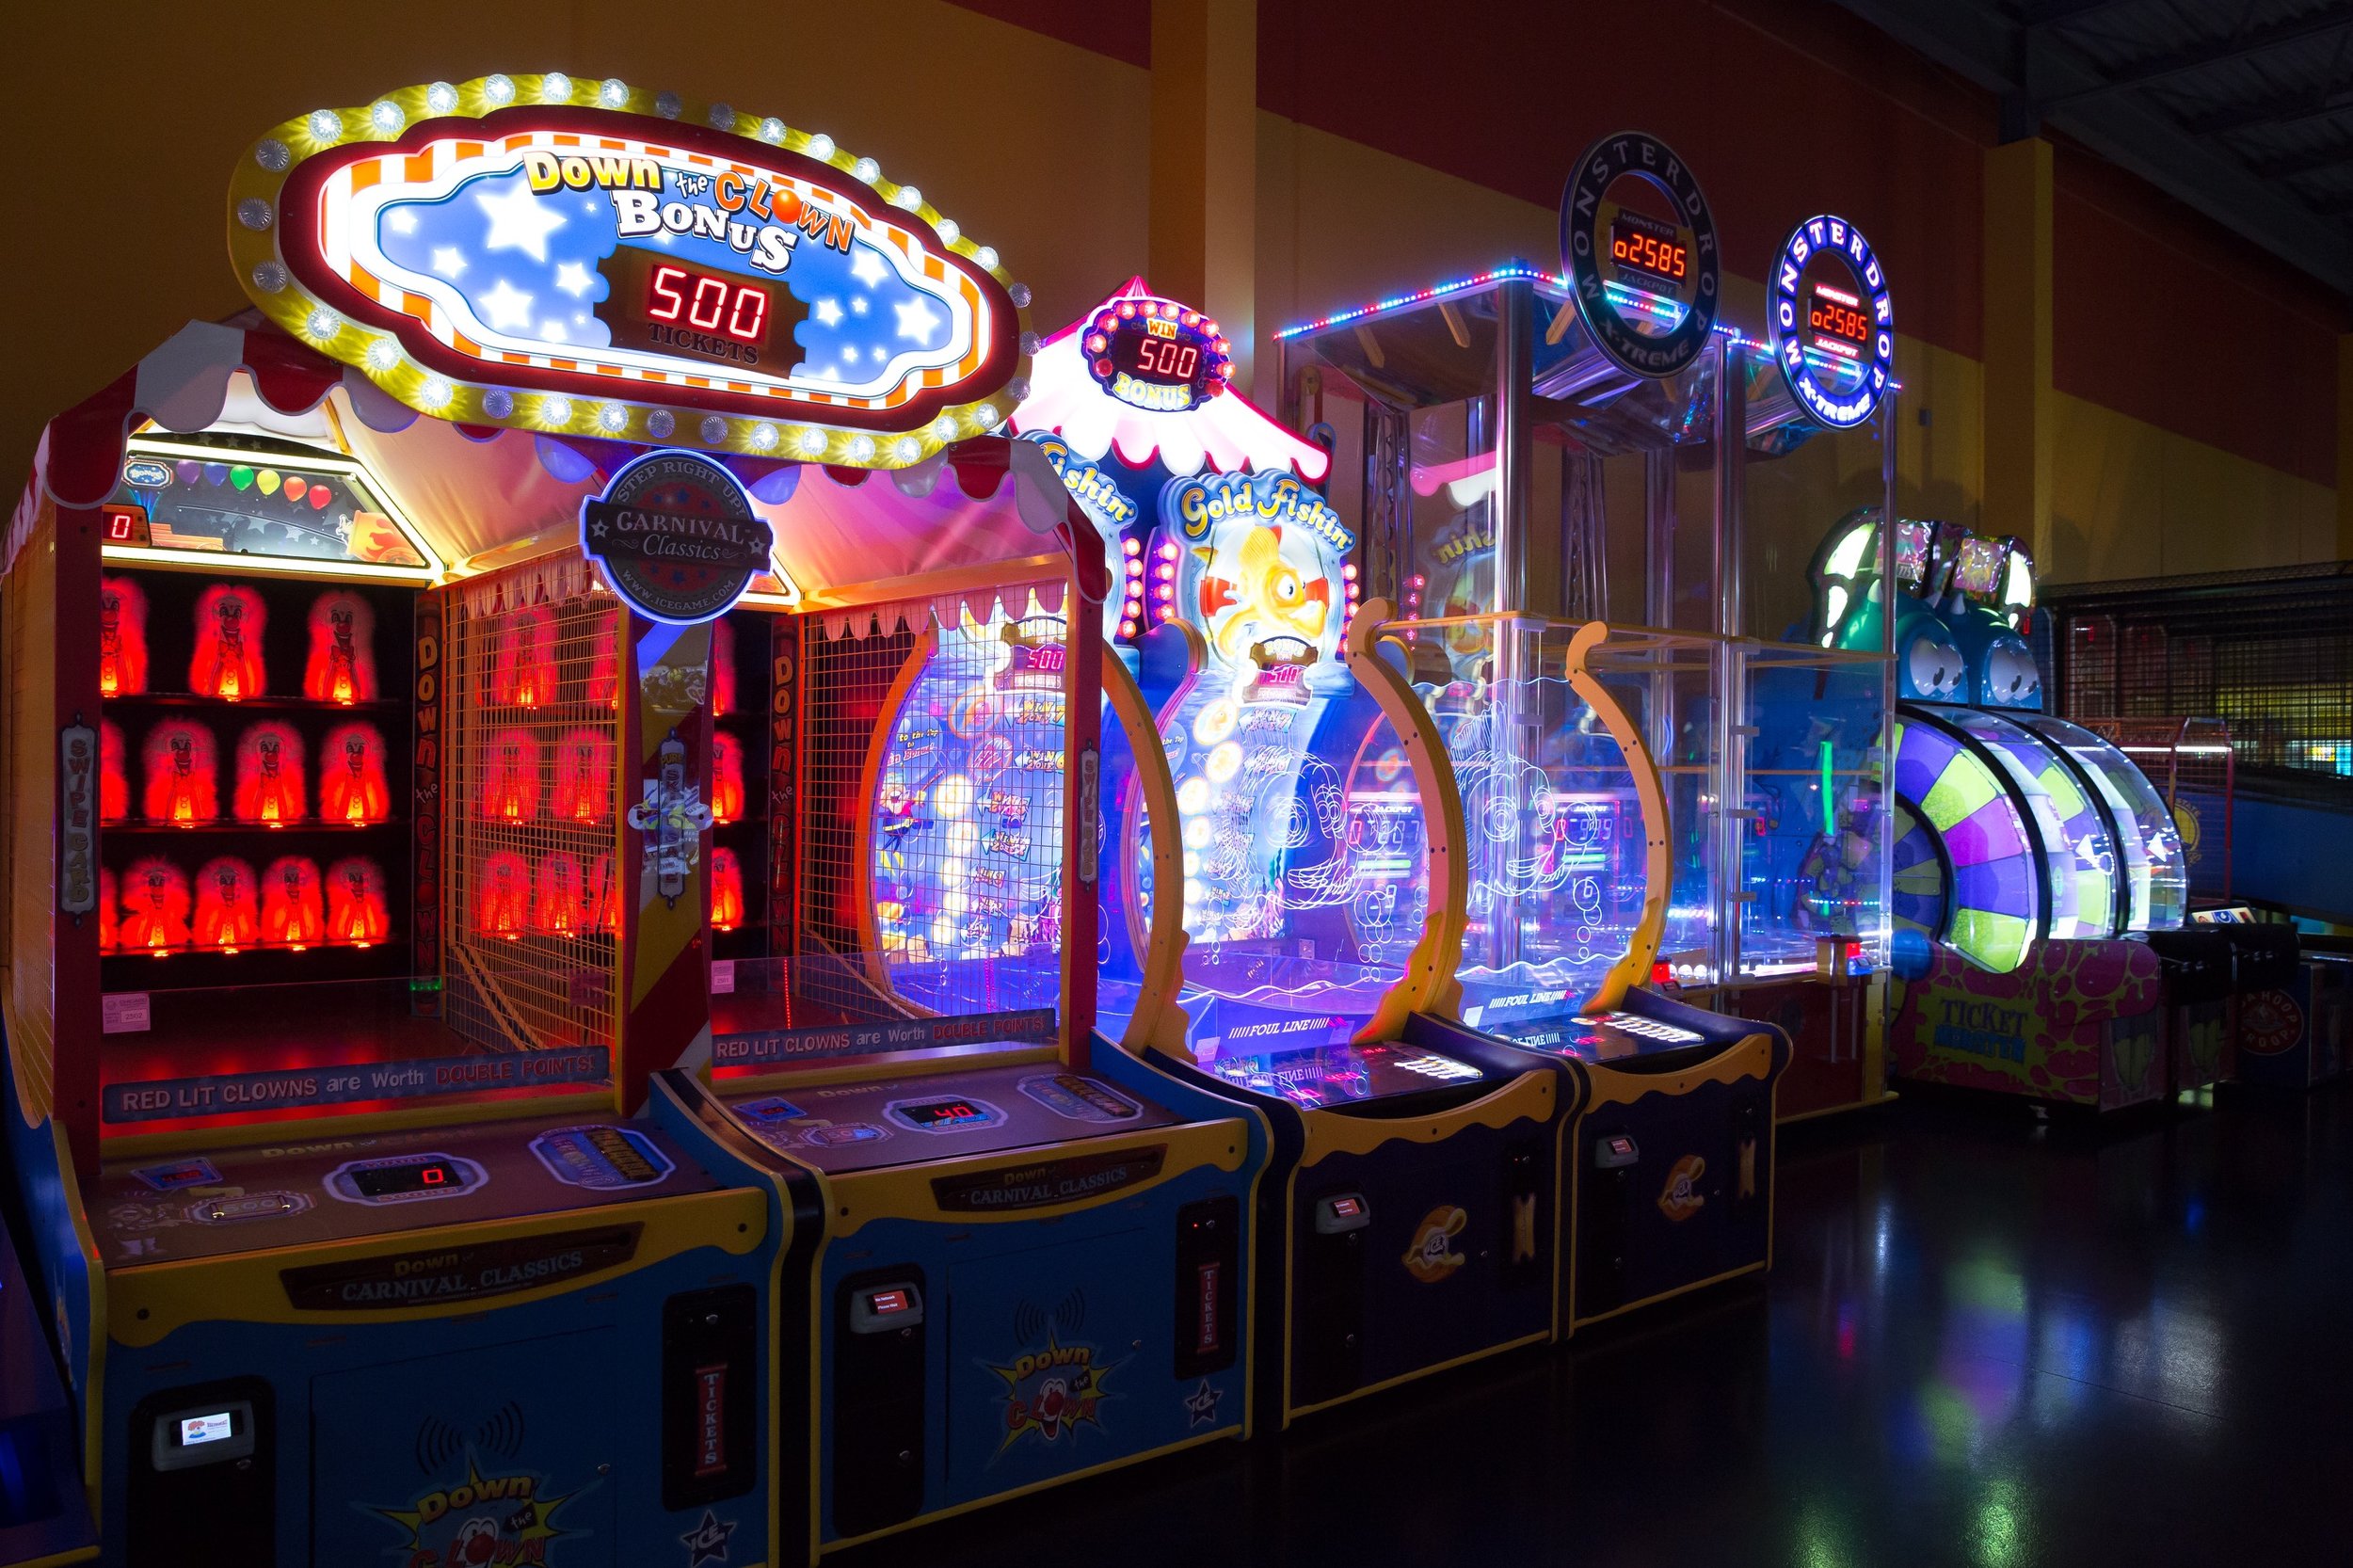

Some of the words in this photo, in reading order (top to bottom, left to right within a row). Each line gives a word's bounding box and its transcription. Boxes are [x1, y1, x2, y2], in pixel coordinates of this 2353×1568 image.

[523, 151, 664, 194] Down
[676, 172, 708, 199] the
[714, 170, 856, 254] CLOWN
[611, 190, 797, 274] BONUS
[1621, 212, 1674, 236] MONSTER
[1619, 272, 1674, 295] JACKPOT
[650, 266, 766, 339] 500
[648, 323, 759, 365] TICKETS
[1147, 320, 1177, 339] WIN
[1138, 340, 1197, 377] 500
[1815, 337, 1859, 358] JACKPOT
[1115, 372, 1191, 409] BONUS
[617, 466, 657, 503] STEP
[663, 461, 721, 485] RIGHT
[722, 485, 746, 516] UP!
[616, 511, 744, 545] CARNIVAL
[1181, 487, 1254, 537] Gold
[643, 534, 722, 560] Classics
[622, 568, 735, 611] WWW.ICEGAME.COM
[416, 635, 439, 770] Down
[773, 656, 793, 778] Down
[661, 753, 684, 769] PURE
[68, 738, 91, 828] SWIPE
[416, 782, 438, 806] the
[772, 787, 792, 808] the
[68, 833, 91, 904] CARD
[416, 815, 438, 968] CLOWN
[1504, 994, 1529, 1007] FOUL
[1529, 991, 1553, 1004] LINE
[1249, 1023, 1280, 1036] FOUL
[1283, 1019, 1311, 1032] LINE
[1939, 999, 2028, 1039] TICKET
[716, 1039, 749, 1060] RED
[755, 1036, 781, 1055] LIT
[785, 1033, 850, 1053] CLOWNS
[856, 1031, 880, 1046] are
[888, 1026, 925, 1043] Worth
[933, 1021, 987, 1040] DOUBLE
[992, 1016, 1046, 1034] POINTS!
[122, 1090, 171, 1112] RED
[178, 1086, 216, 1109] LIT
[223, 1078, 318, 1105] CLOWNS
[327, 1074, 360, 1094] are
[371, 1069, 424, 1089] Worth
[436, 1061, 513, 1086] DOUBLE
[521, 1055, 596, 1078] POINTS!
[817, 1085, 884, 1098] Down
[934, 1106, 974, 1121] 40
[261, 1142, 354, 1158] Down
[422, 1168, 444, 1184] 0
[970, 1183, 1053, 1205] CARNIVAL
[1060, 1166, 1128, 1192] CLASSICS
[1004, 1166, 1047, 1186] Down
[342, 1273, 470, 1302] CARNIVAL
[480, 1251, 584, 1288] CLASSICS
[393, 1254, 458, 1278] Down
[1203, 1271, 1216, 1346] TICKETS
[1016, 1348, 1091, 1380] Down
[1074, 1375, 1090, 1391] the
[702, 1372, 723, 1465] TICKETS
[1190, 1391, 1214, 1412] ICE
[416, 1476, 535, 1525] Down
[510, 1511, 532, 1529] the
[690, 1525, 726, 1552] ICE
